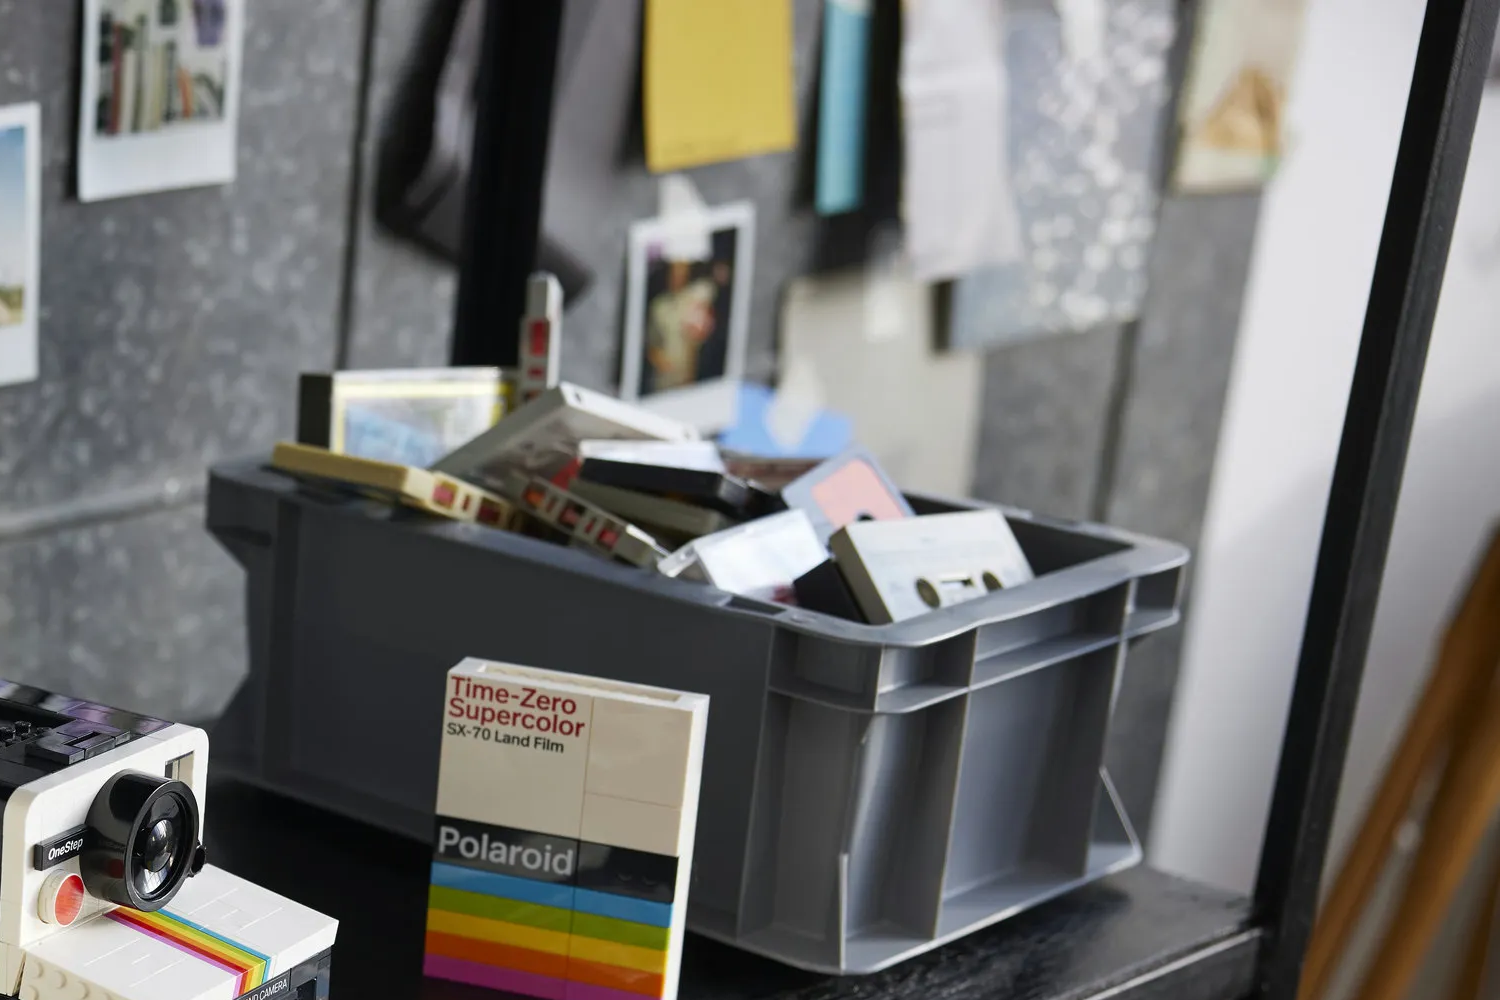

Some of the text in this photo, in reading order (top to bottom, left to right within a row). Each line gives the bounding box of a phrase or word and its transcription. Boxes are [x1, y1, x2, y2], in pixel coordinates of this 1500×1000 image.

[451, 675, 577, 715] Time-Zero
[448, 697, 585, 738] Supercolor
[446, 722, 565, 753] SX-70 Land Film
[48, 838, 84, 861] OneStep
[438, 826, 575, 877] Polaroid
[259, 978, 288, 1000] CAMERA
